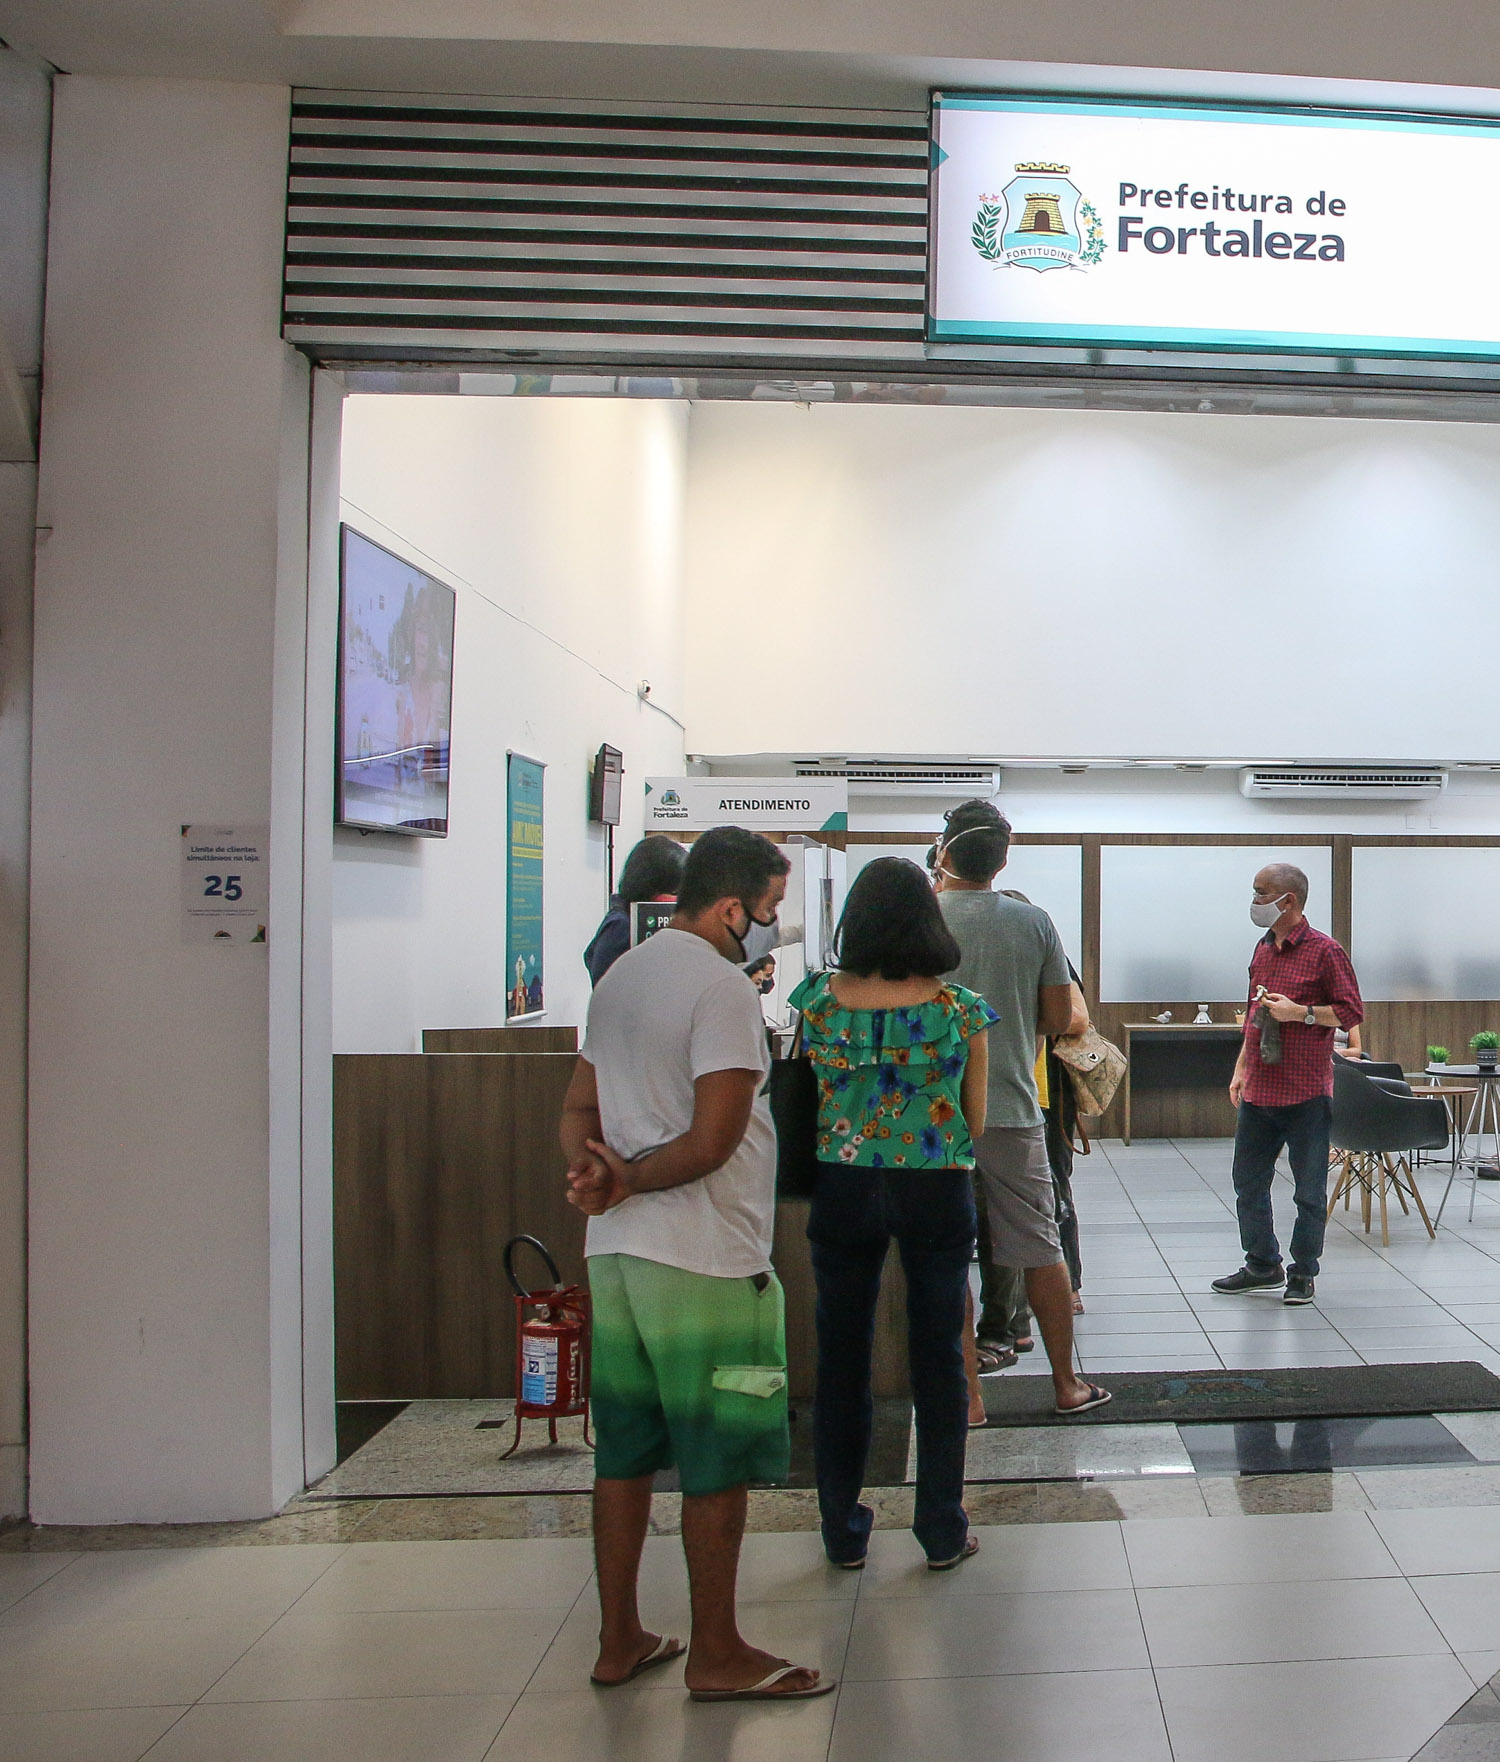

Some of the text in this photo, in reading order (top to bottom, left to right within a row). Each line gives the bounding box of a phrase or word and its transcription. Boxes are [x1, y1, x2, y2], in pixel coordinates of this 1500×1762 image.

[1119, 182, 1347, 217] Prefeitura de
[1117, 216, 1345, 262] Fortaleza
[1006, 247, 1074, 262] FORTITUDINE
[718, 799, 811, 811] ATENDIMENTO
[204, 875, 243, 901] 25
